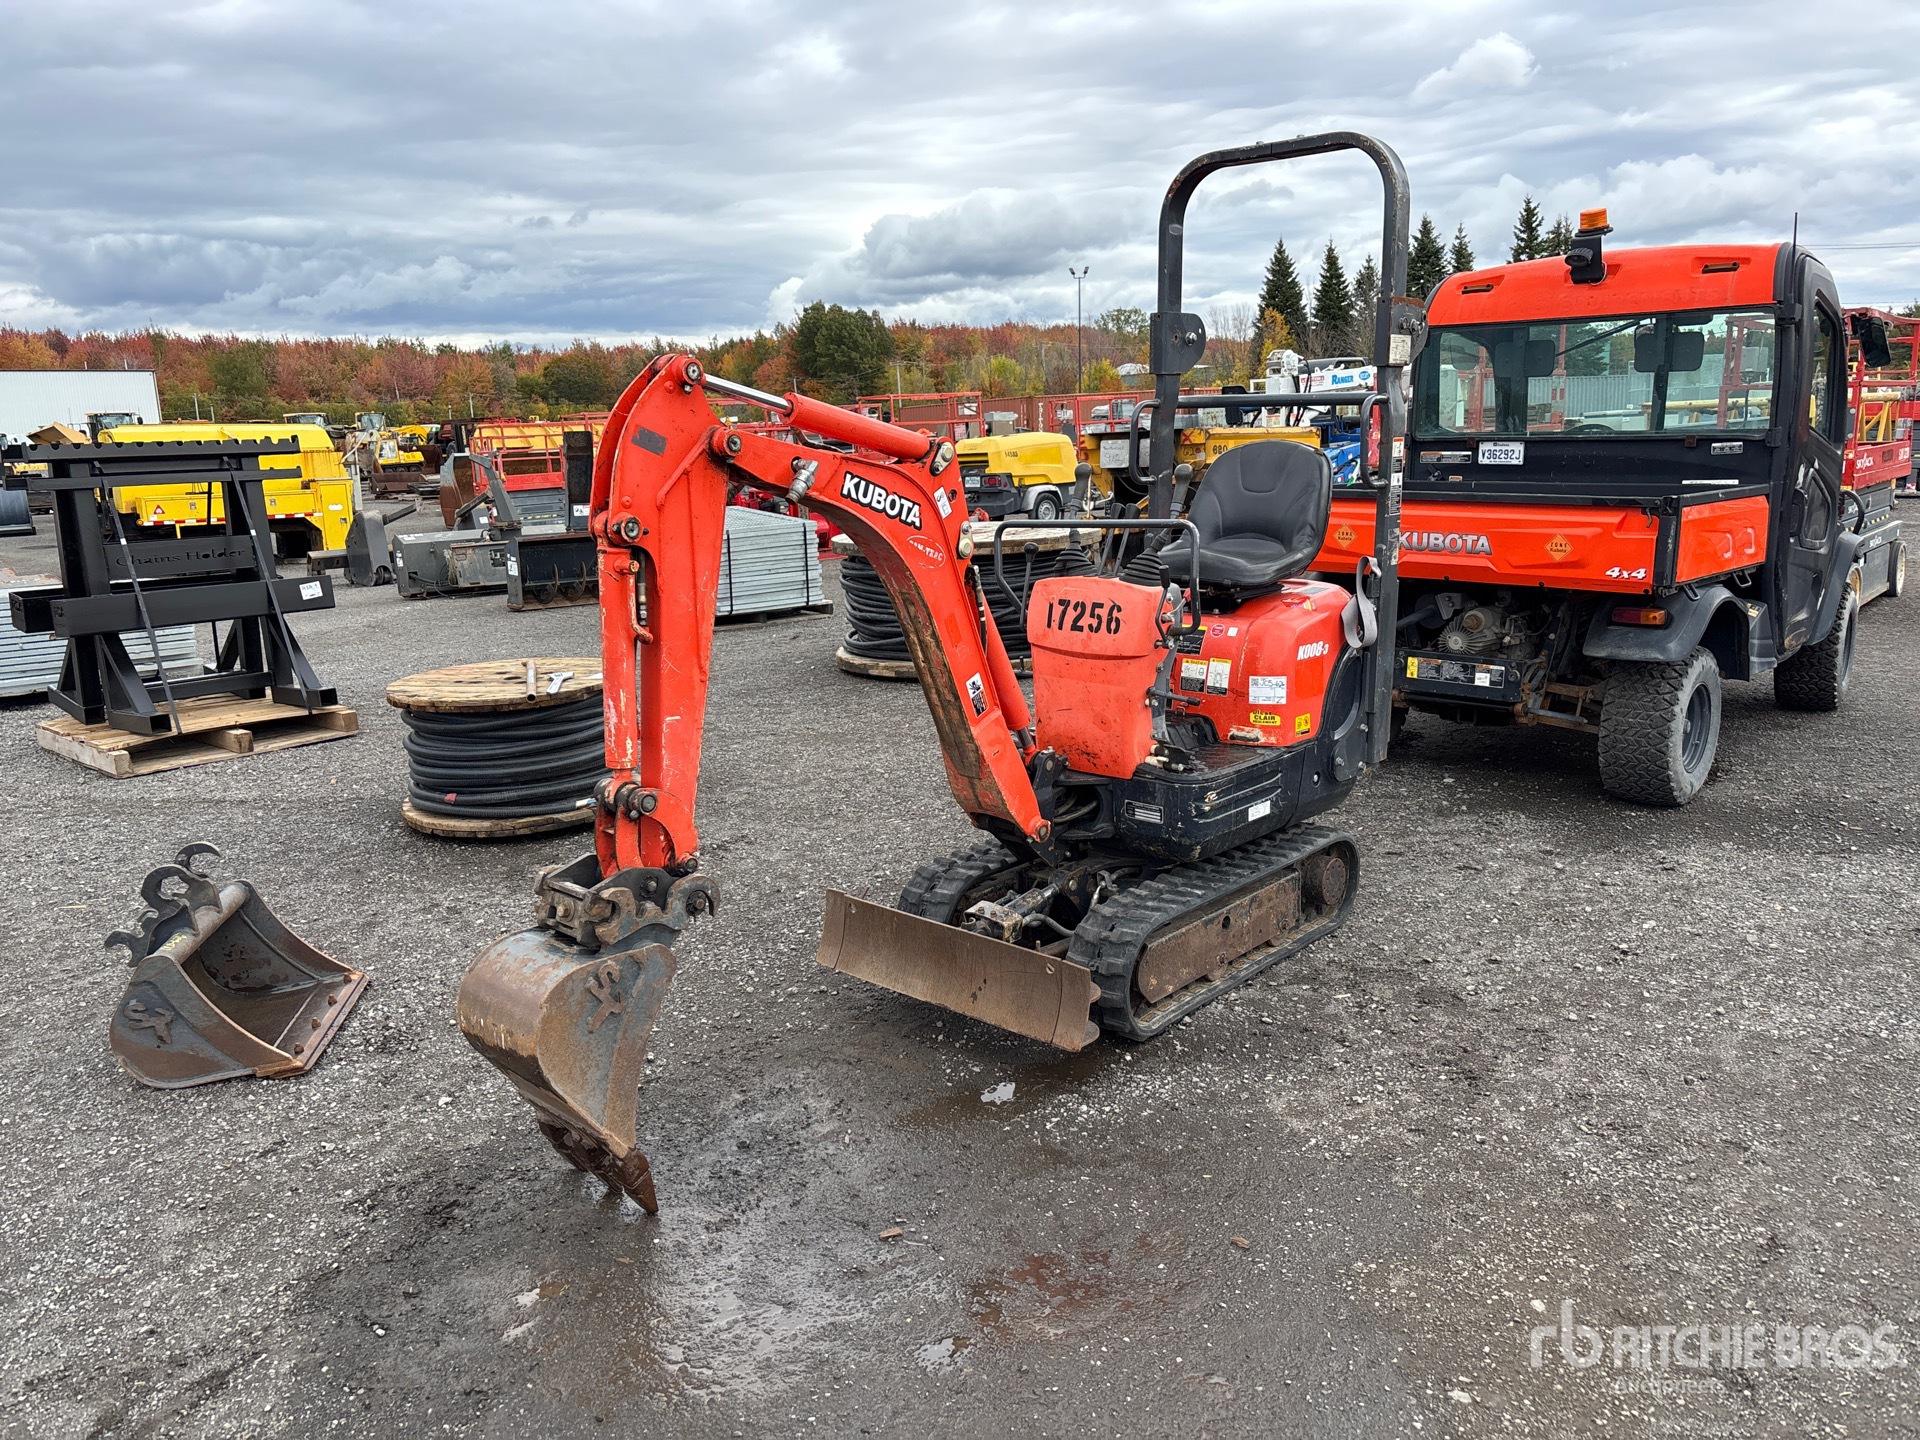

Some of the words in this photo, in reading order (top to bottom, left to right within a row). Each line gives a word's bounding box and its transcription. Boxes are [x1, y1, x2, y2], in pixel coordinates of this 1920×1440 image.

[1331, 373, 1354, 385] RANGER
[1481, 448, 1521, 460] V36292J
[840, 471, 922, 531] KUBOTA
[1398, 530, 1493, 556] KUBOTA
[115, 554, 180, 566] Chains
[185, 547, 246, 561] Holder
[1605, 566, 1647, 579] 4x4
[1047, 598, 1122, 635] 17256
[1297, 640, 1329, 661] K008-3
